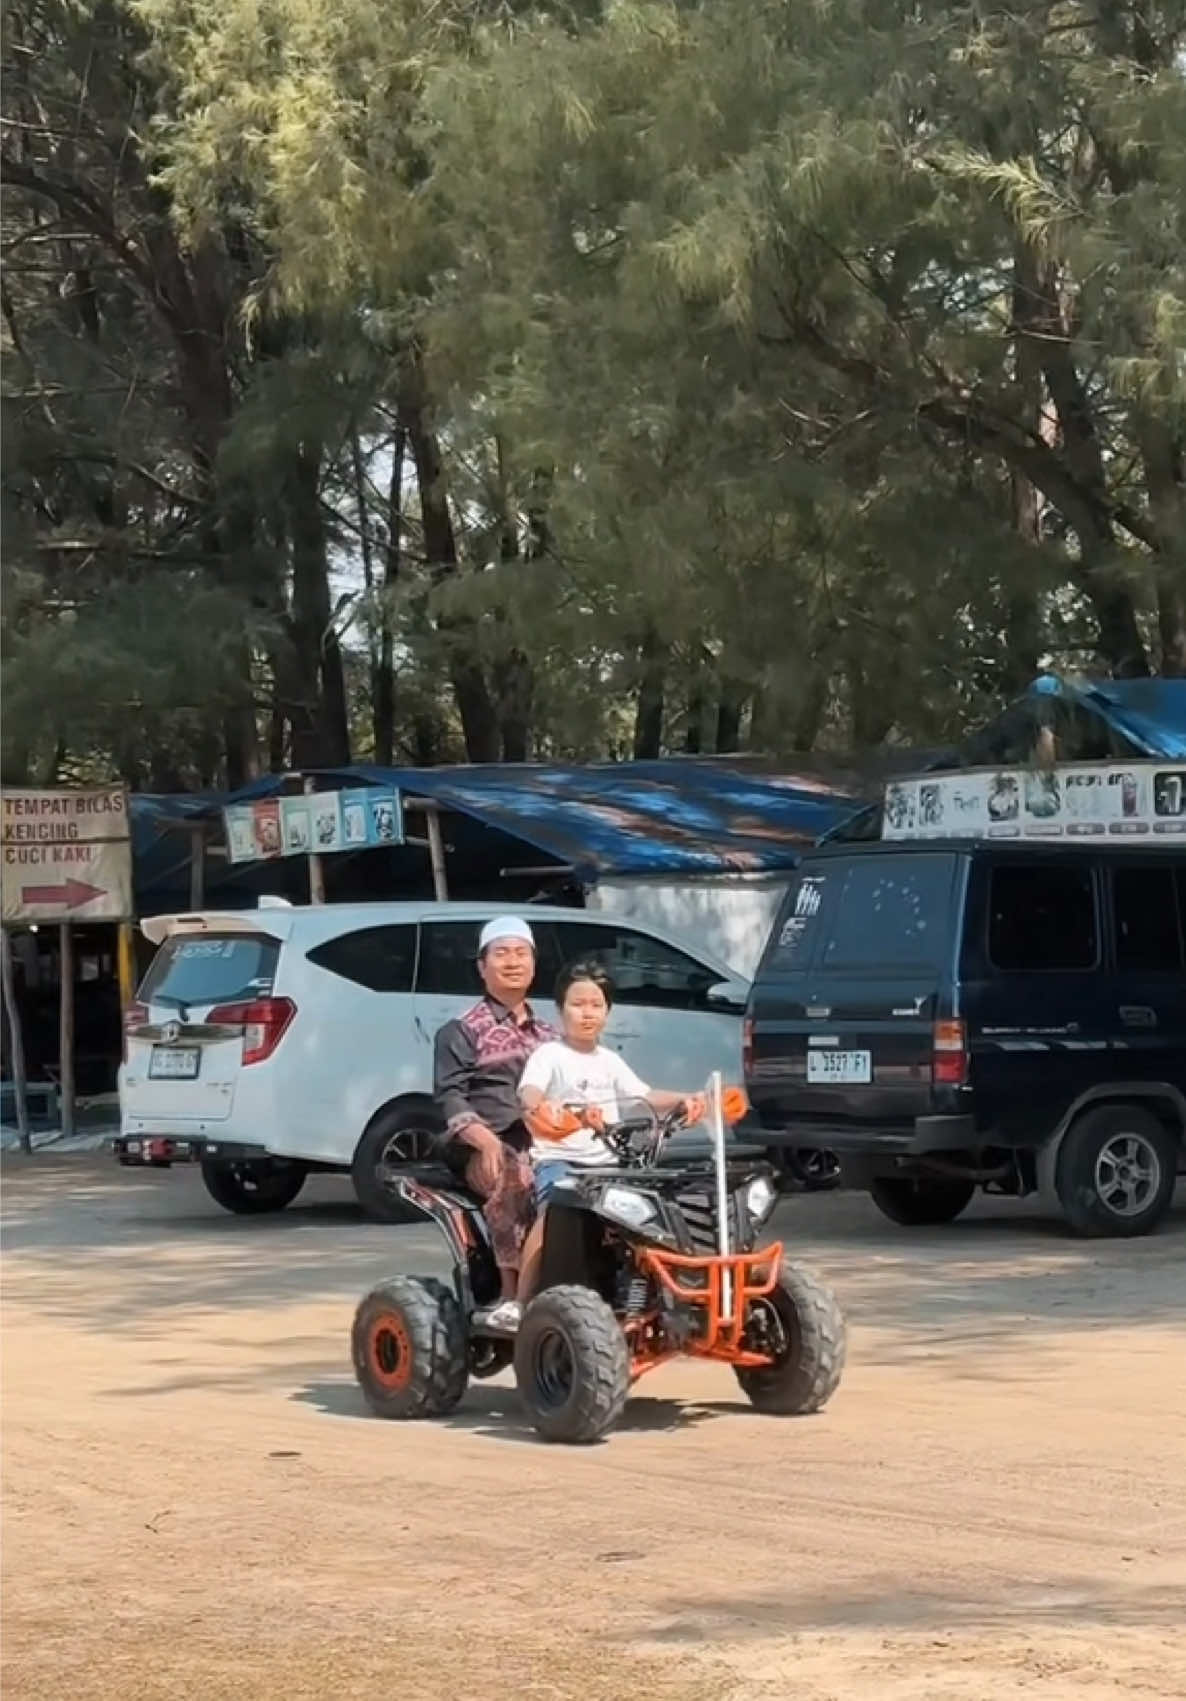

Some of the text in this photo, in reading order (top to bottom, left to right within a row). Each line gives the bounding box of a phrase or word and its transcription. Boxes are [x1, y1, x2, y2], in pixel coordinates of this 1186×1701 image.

[5, 795, 123, 815] TEMPAT BILAS
[5, 822, 79, 840] KENCING
[5, 846, 92, 864] CUCI KAKI
